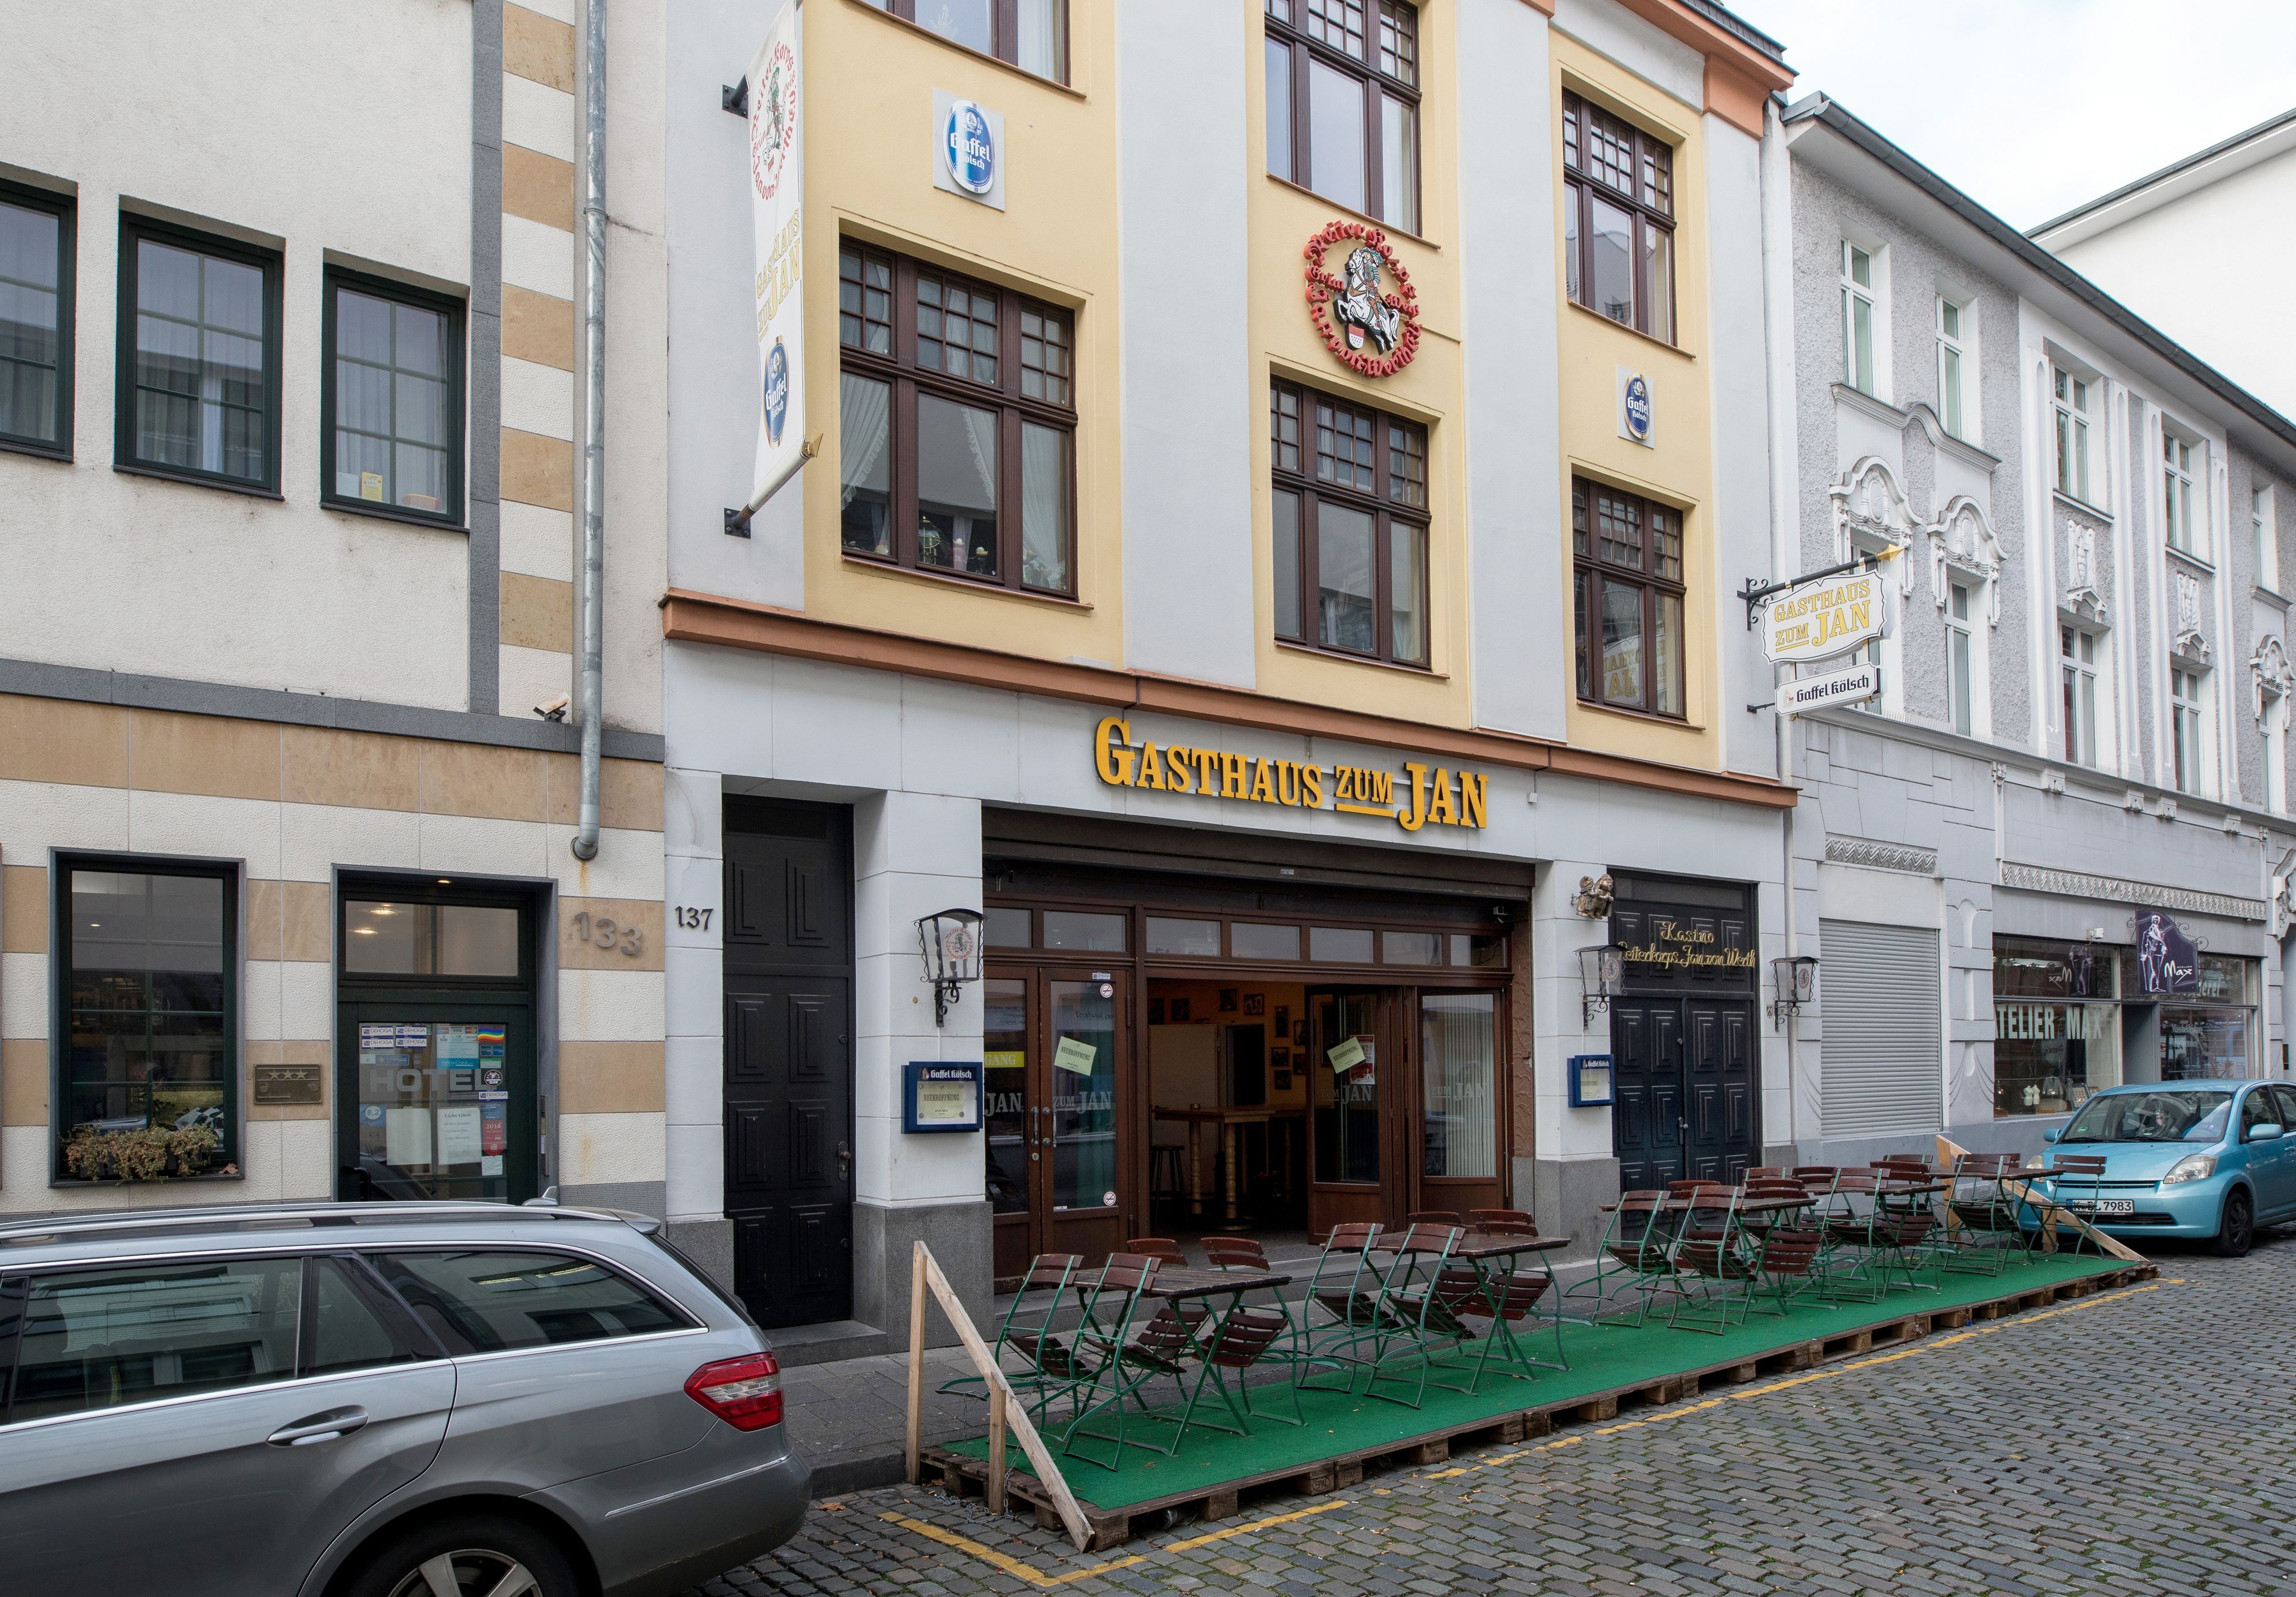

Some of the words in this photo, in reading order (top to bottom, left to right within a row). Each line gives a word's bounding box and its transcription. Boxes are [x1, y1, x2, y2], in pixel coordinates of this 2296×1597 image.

[950, 133, 991, 162] Gaffel
[768, 238, 800, 320] JAN
[766, 372, 787, 410] Gaffel
[1627, 396, 1649, 416] Gaffel
[1632, 410, 1647, 422] Kölsch
[1774, 579, 1871, 622] GASTHAUS
[1775, 623, 1809, 646] ZUM
[1812, 600, 1871, 646] JAN
[1797, 684, 1829, 703] Gaffel
[1831, 675, 1870, 694] Kölsch
[1334, 765, 1394, 804] ZUM
[1397, 762, 1488, 831] JAN
[675, 906, 714, 931] 137
[573, 911, 642, 956] 133
[1661, 921, 1714, 945] Kasino
[1680, 945, 1704, 968] Jan
[1706, 955, 1724, 968] von
[1723, 947, 1756, 968] Werth
[2164, 960, 2192, 984] Max
[2066, 1006, 2102, 1040] MAX
[1060, 1046, 1091, 1062] NEUERÖFFNUNG
[370, 1069, 497, 1092] HOTEL
[930, 1069, 951, 1079] Gaffel
[951, 1070, 972, 1079] Kölsch
[924, 1092, 960, 1102] NEUERÖFFNUNG
[984, 1092, 1022, 1117] JAN
[1053, 1096, 1075, 1107] ZUM
[1076, 1091, 1111, 1114] JAN
[1341, 1084, 1372, 1104] JAN
[2103, 1201, 2132, 1211] 7983
